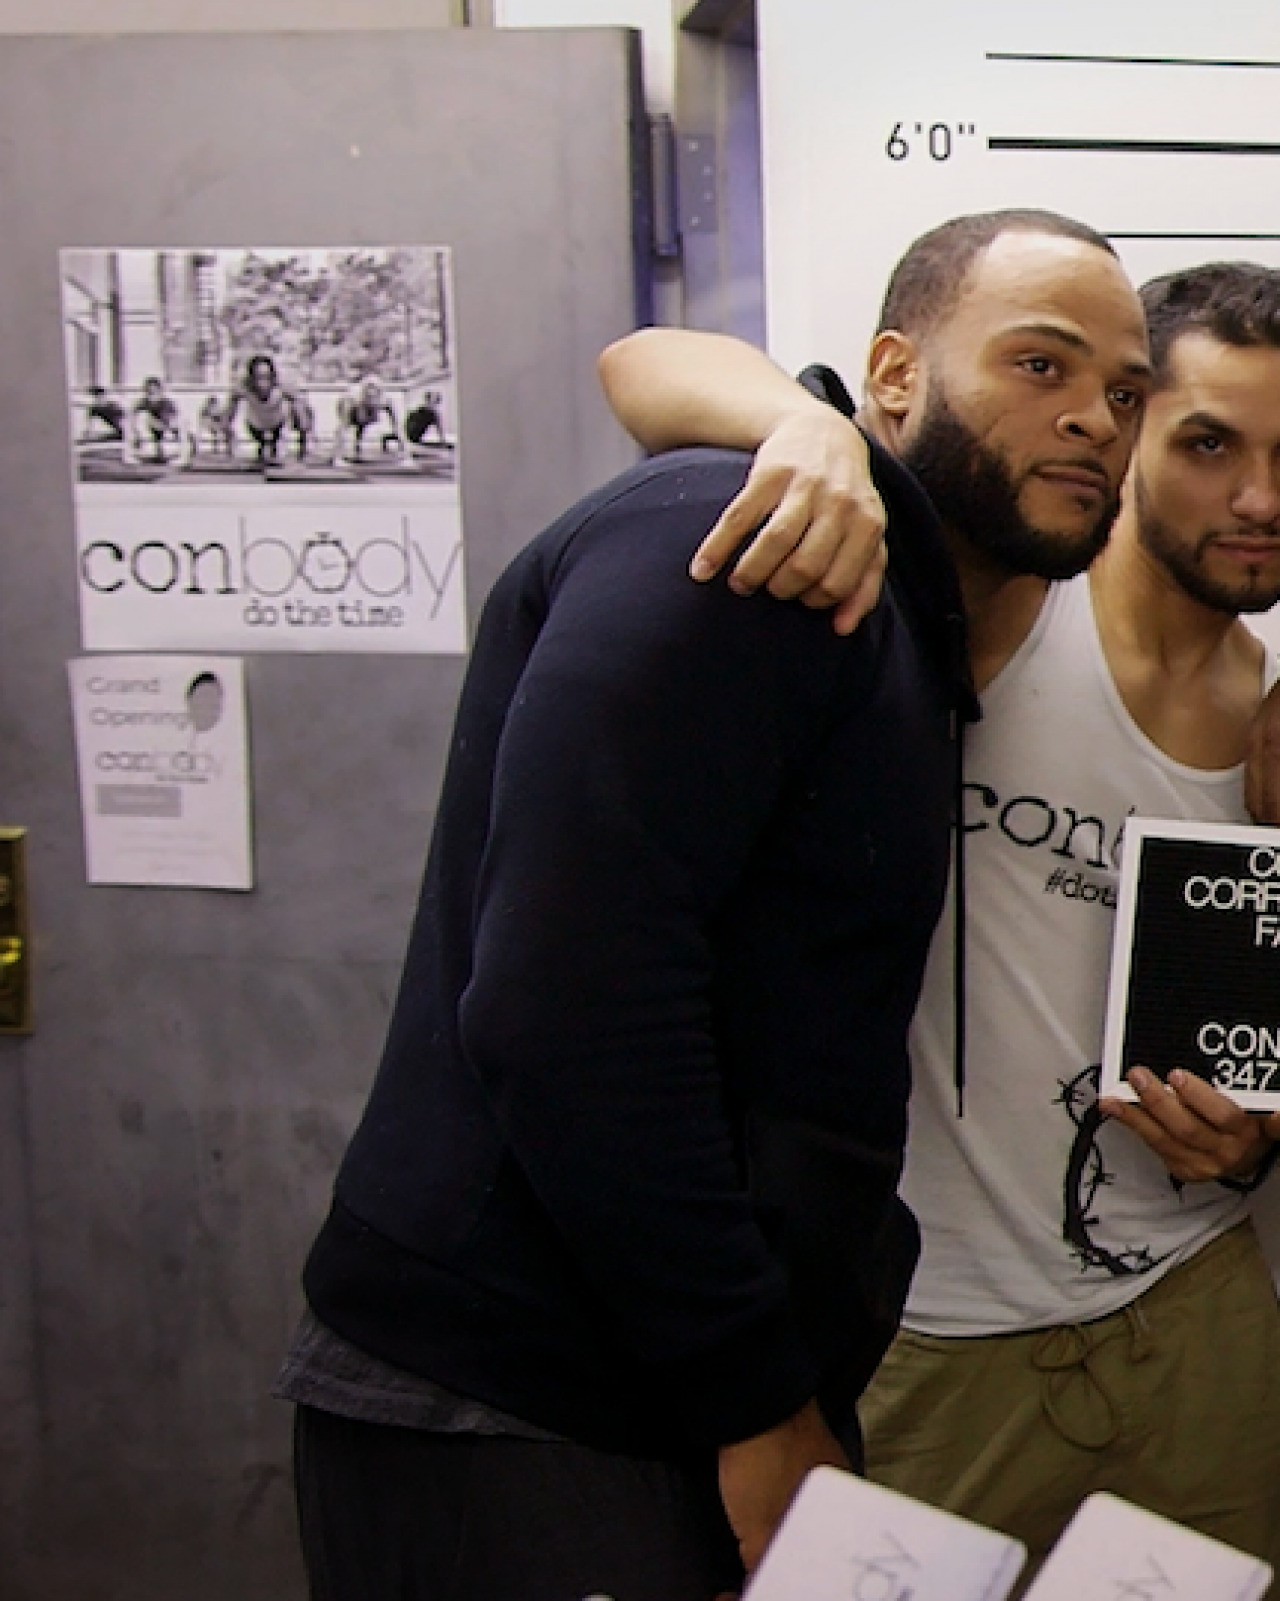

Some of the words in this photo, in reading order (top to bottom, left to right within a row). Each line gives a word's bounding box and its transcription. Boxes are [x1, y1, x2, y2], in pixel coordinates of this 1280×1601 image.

[885, 121, 975, 161] 6'0"
[80, 514, 462, 621] conbody
[243, 598, 279, 627] do
[284, 601, 332, 628] the
[337, 599, 404, 628] time
[1212, 1057, 1278, 1092] 347
